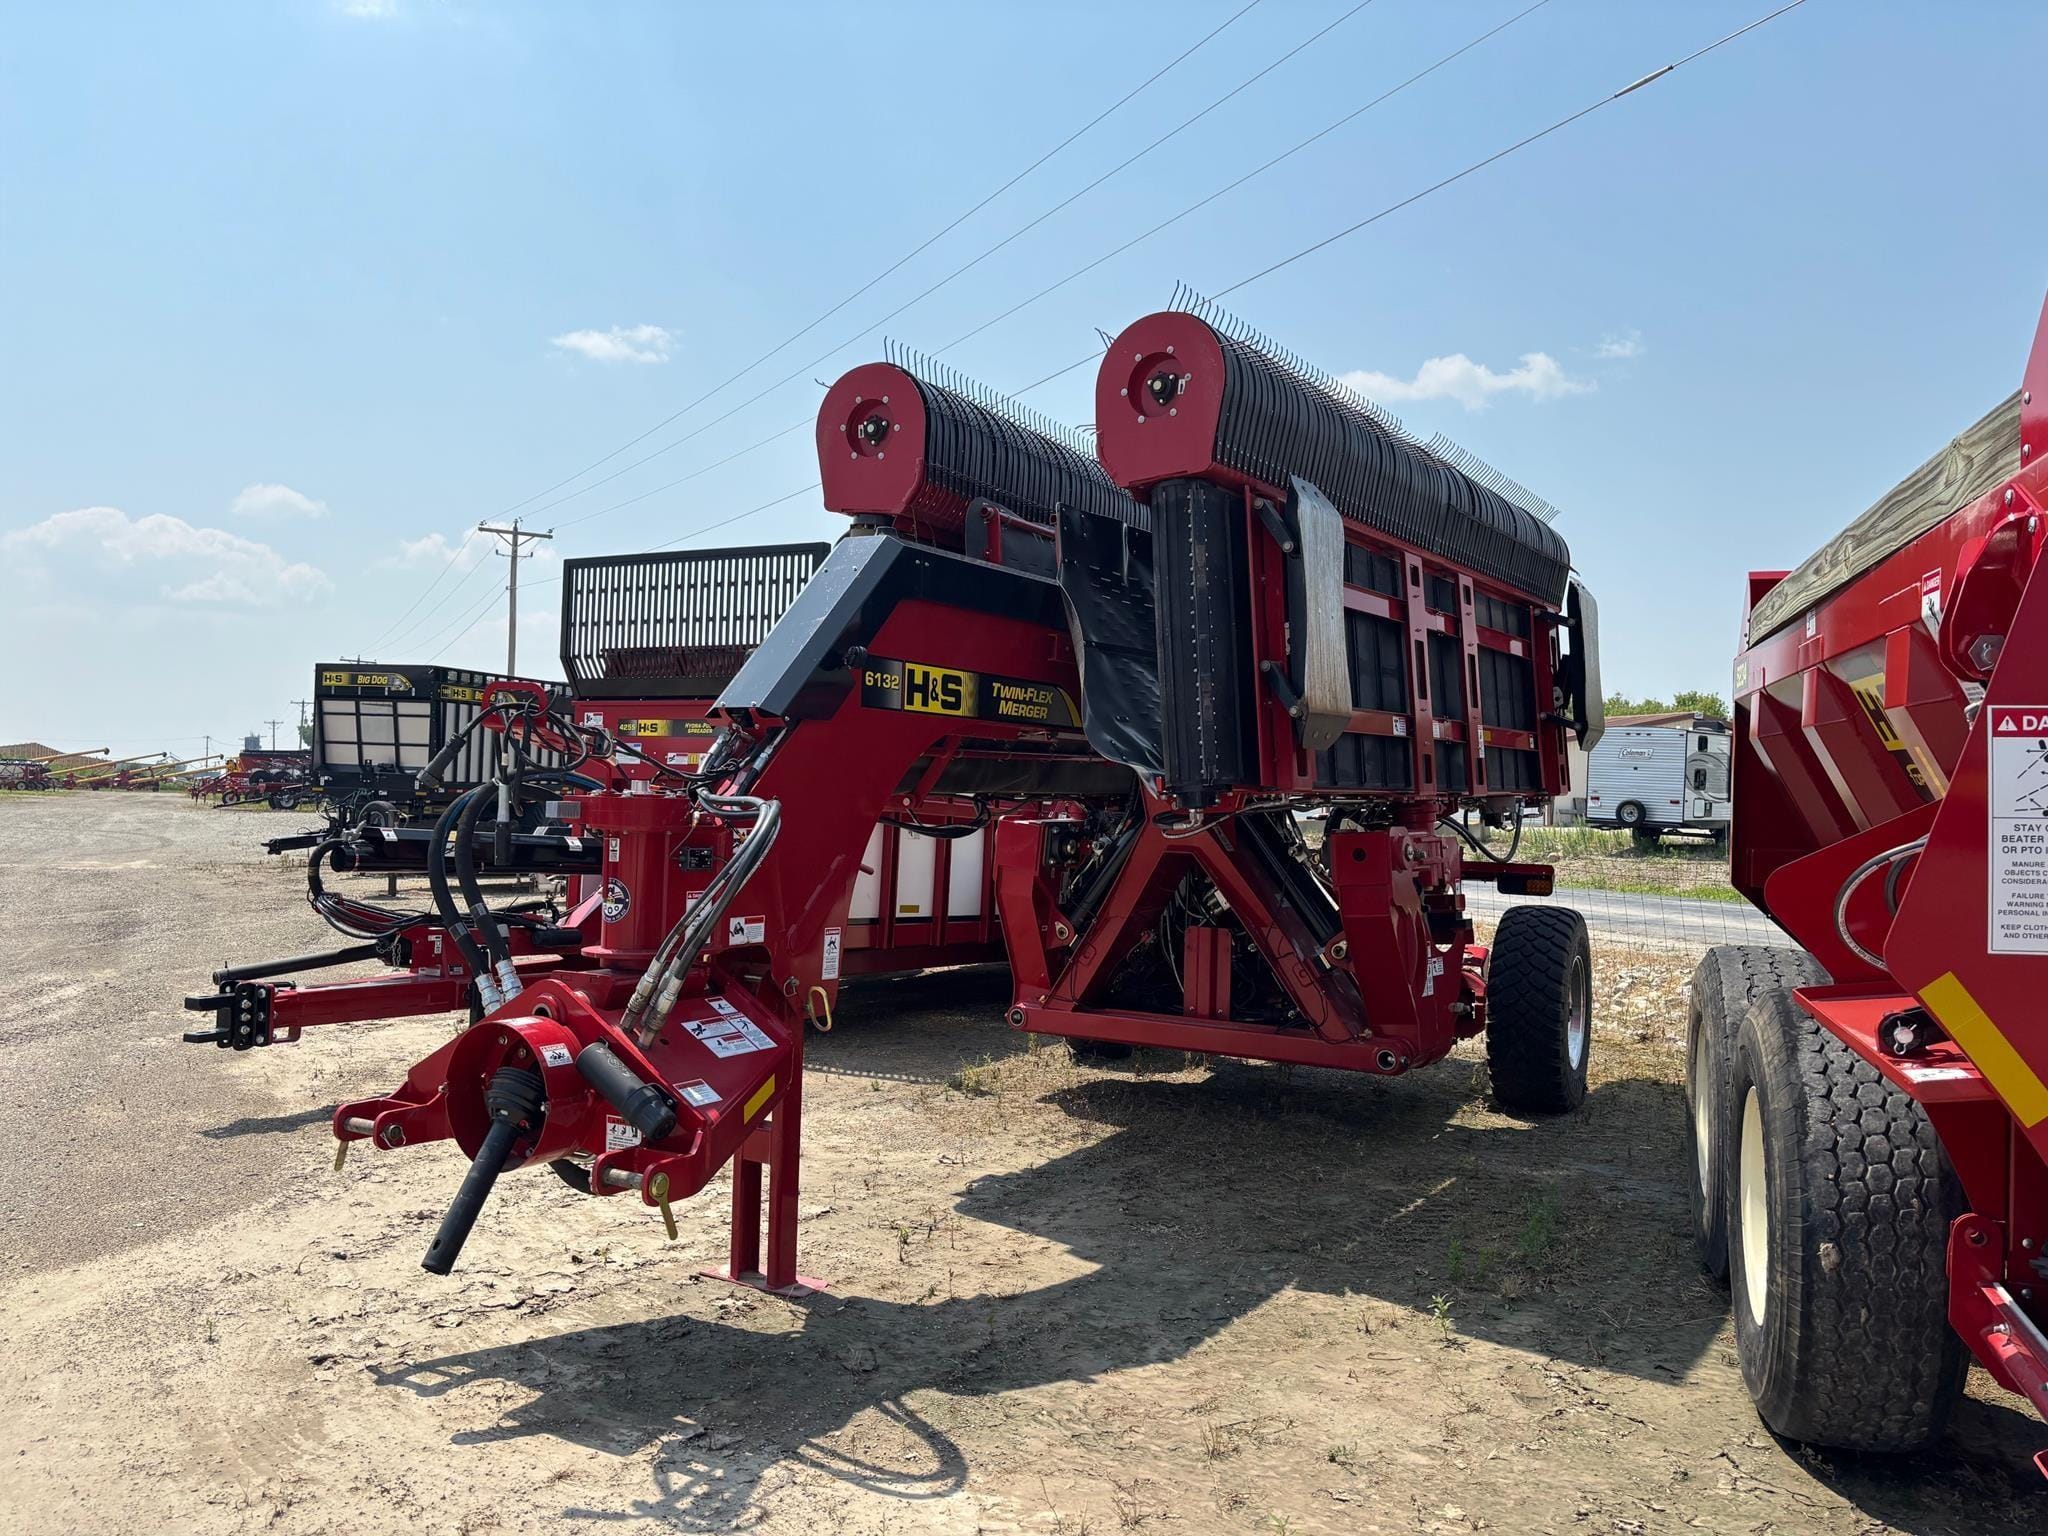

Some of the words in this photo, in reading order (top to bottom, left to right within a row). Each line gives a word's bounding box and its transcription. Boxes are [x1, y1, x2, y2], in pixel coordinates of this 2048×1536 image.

[865, 671, 900, 690] 6132
[906, 668, 963, 711] H&S
[998, 700, 1049, 720] MERGER
[2014, 824, 2042, 832] STAY
[2001, 835, 2044, 843] BEATER
[2002, 845, 2017, 854] OR
[2020, 846, 2043, 854] PTO
